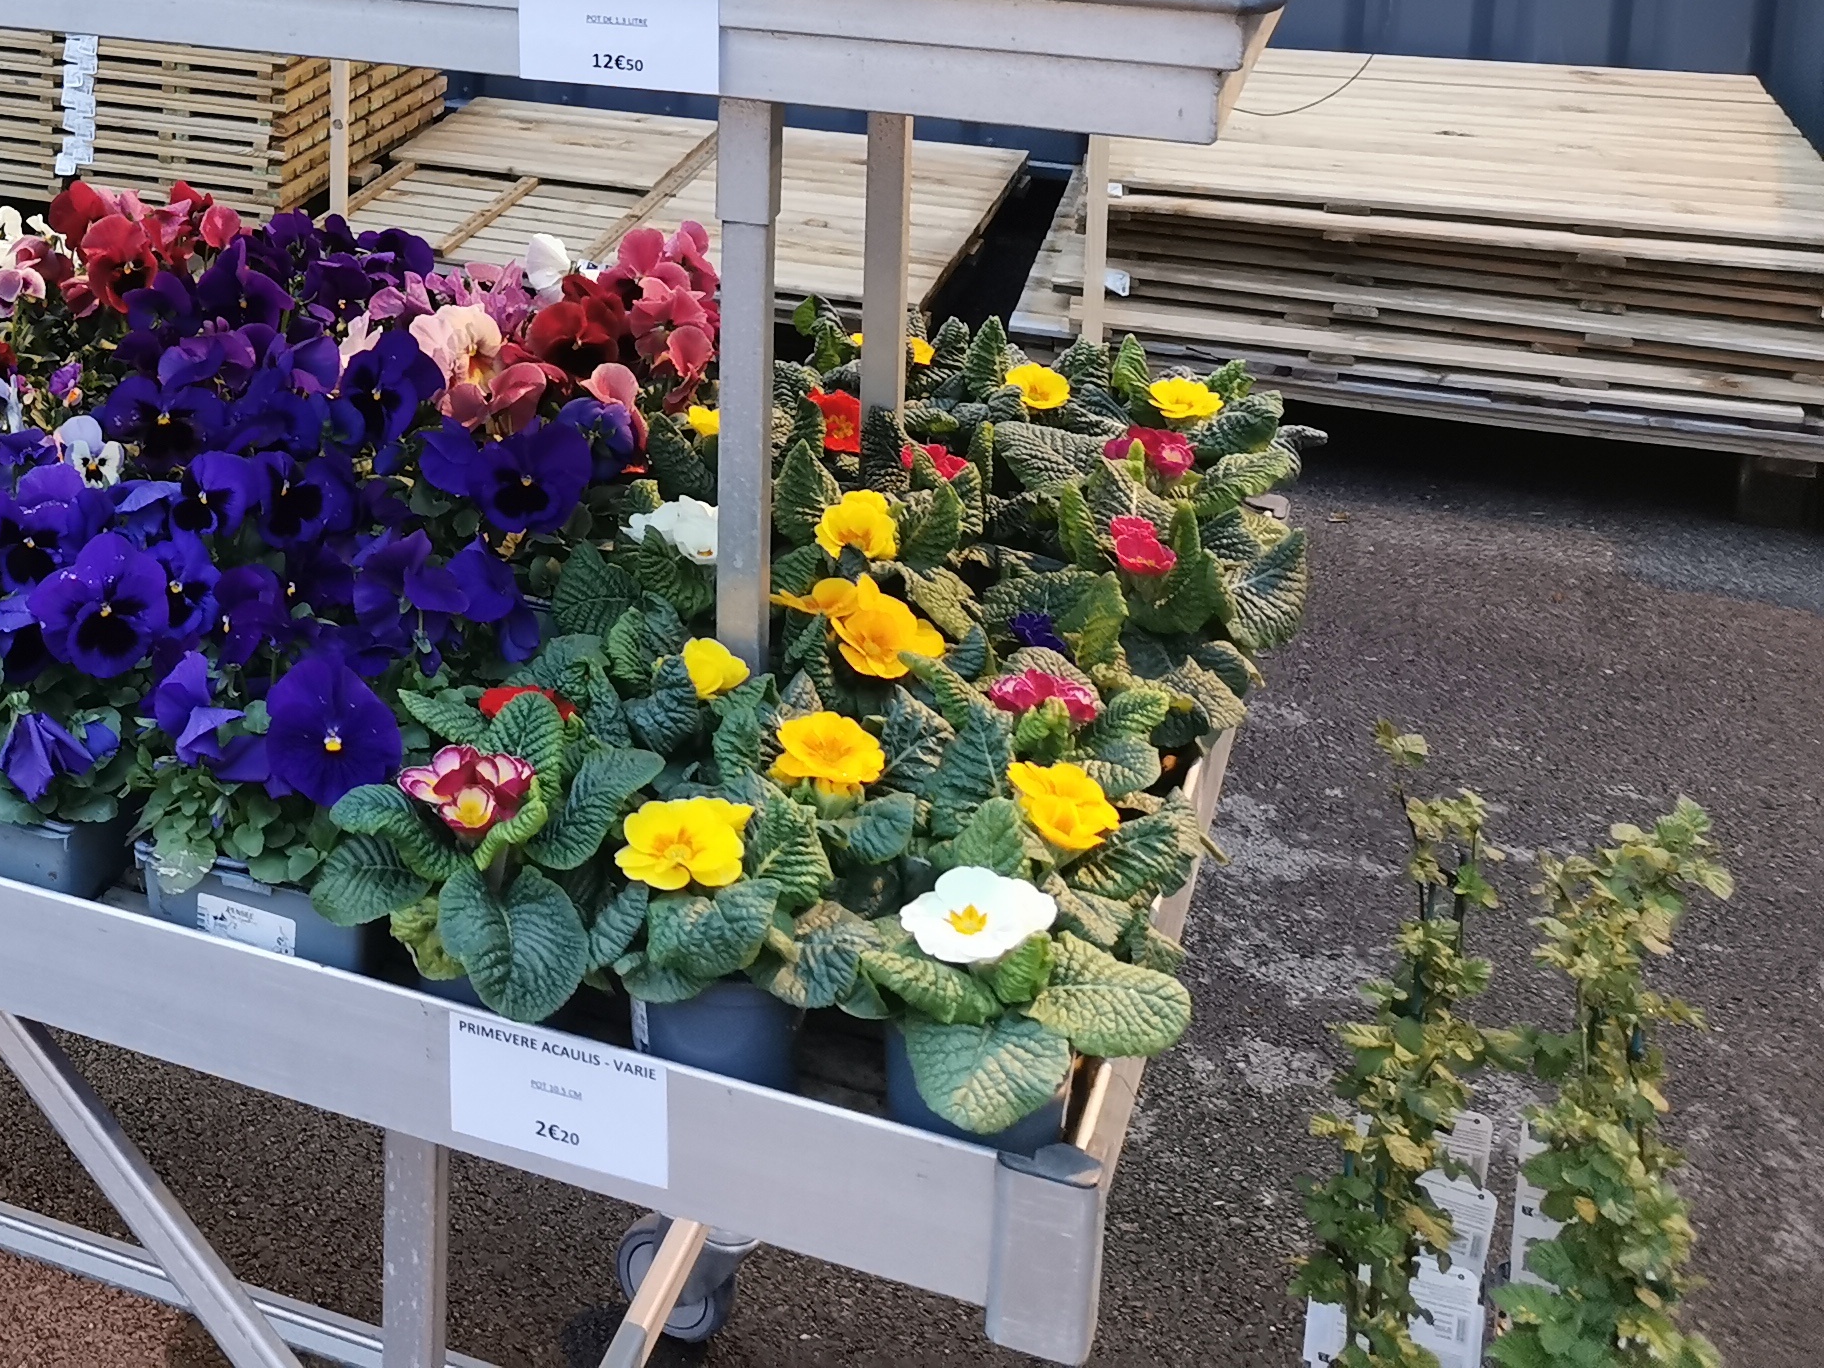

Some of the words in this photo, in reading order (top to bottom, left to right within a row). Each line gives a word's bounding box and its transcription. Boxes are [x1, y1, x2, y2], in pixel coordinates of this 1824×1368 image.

[586, 14, 601, 24] POT
[603, 15, 613, 24] DE
[592, 53, 644, 72] 12€50
[459, 1020, 538, 1051] PRIMEVERE
[541, 1041, 601, 1066] ACAULIS
[613, 1059, 657, 1081] VARIE
[535, 1120, 580, 1146] 2€20
